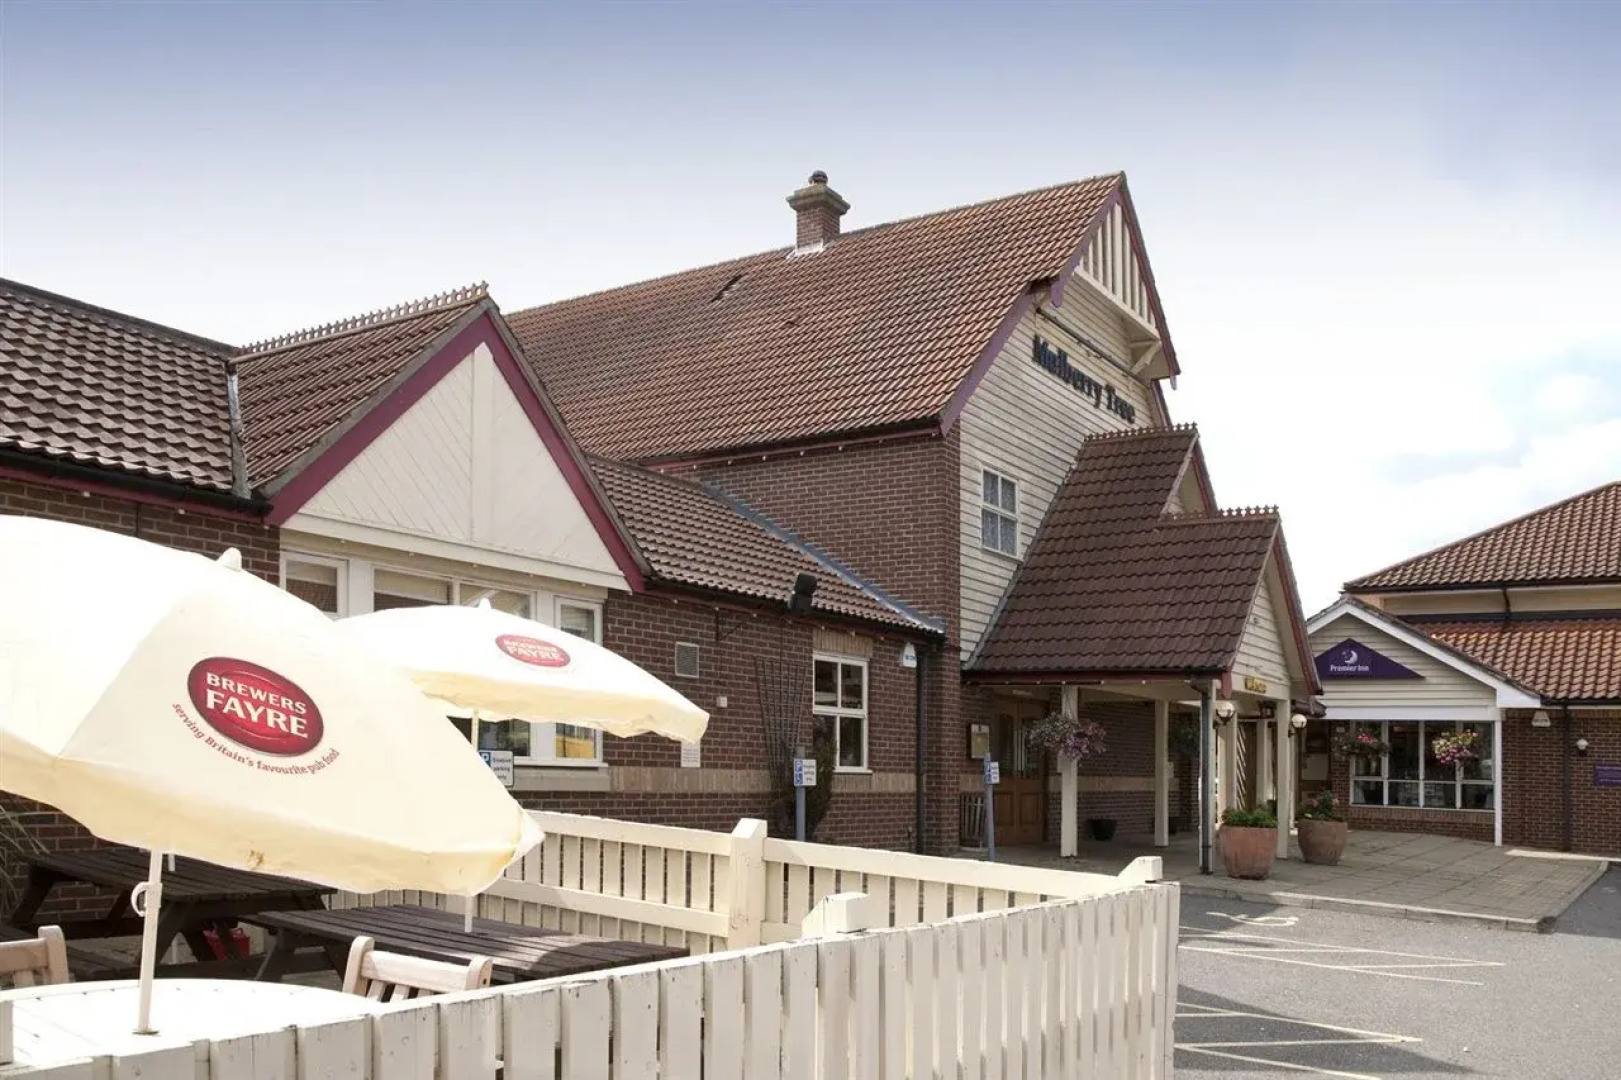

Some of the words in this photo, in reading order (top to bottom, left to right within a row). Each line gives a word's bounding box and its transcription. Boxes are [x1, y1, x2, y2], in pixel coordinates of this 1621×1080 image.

[1330, 664, 1357, 672] Premier
[1357, 664, 1370, 672] Inn
[206, 671, 307, 715] BREWERS
[206, 688, 308, 739] FAYRE
[172, 703, 205, 739] serving
[205, 736, 254, 767] Britain's
[257, 760, 308, 774] favourite
[307, 760, 326, 774] pub
[322, 747, 340, 765] food
